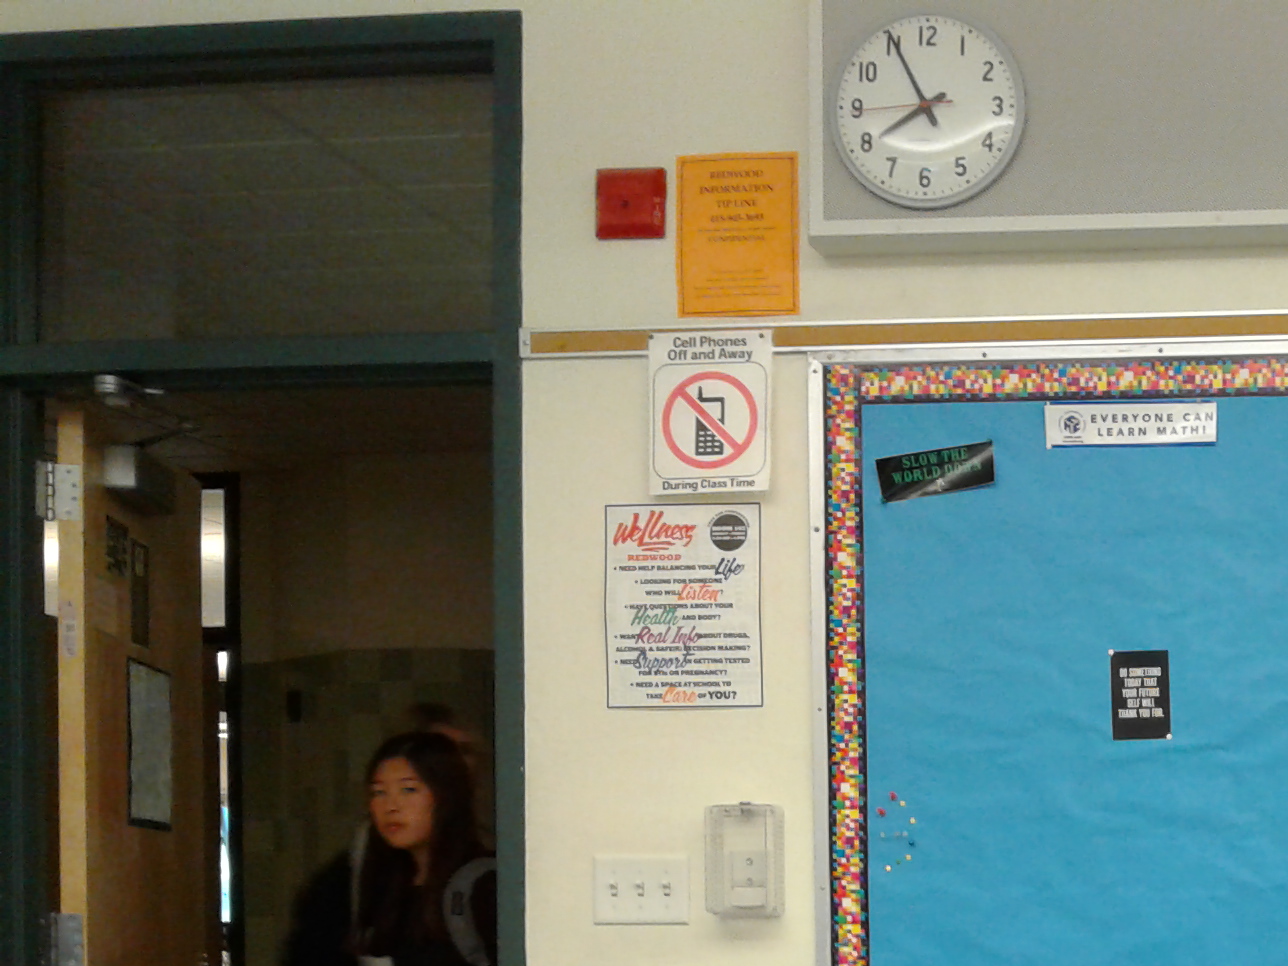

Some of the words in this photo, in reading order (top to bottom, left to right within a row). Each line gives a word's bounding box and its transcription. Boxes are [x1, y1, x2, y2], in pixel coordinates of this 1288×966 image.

[918, 25, 938, 47] 12
[959, 34, 966, 56] 1
[858, 61, 877, 83] 10
[982, 60, 994, 82] 2
[851, 98, 863, 119] 9
[991, 96, 1004, 117] 3
[860, 132, 873, 153] 8
[981, 131, 994, 153] 4
[885, 156, 898, 178] 7
[954, 156, 967, 177] 5
[919, 167, 931, 188] 6
[699, 183, 774, 195] INFORMATION
[672, 336, 697, 349] Cell
[700, 335, 748, 348] Phones
[667, 349, 688, 361] Off
[691, 349, 716, 360] and
[718, 348, 754, 362] Away
[1090, 412, 1175, 424] EVERYONE
[1182, 411, 1214, 422] CAN
[1097, 426, 1148, 437] LEARN
[1156, 424, 1207, 436] MATH!
[902, 452, 939, 469] SLOW
[941, 447, 969, 463] THE
[662, 480, 699, 491] During
[700, 479, 727, 490] Class
[730, 478, 756, 488] Time
[891, 465, 941, 485] WORLD
[612, 510, 697, 547] Wellness
[627, 554, 682, 562] REDWOOD
[635, 626, 671, 645] Real
[633, 651, 695, 671] Support
[662, 686, 698, 703] Care
[708, 691, 737, 700] YOU?
